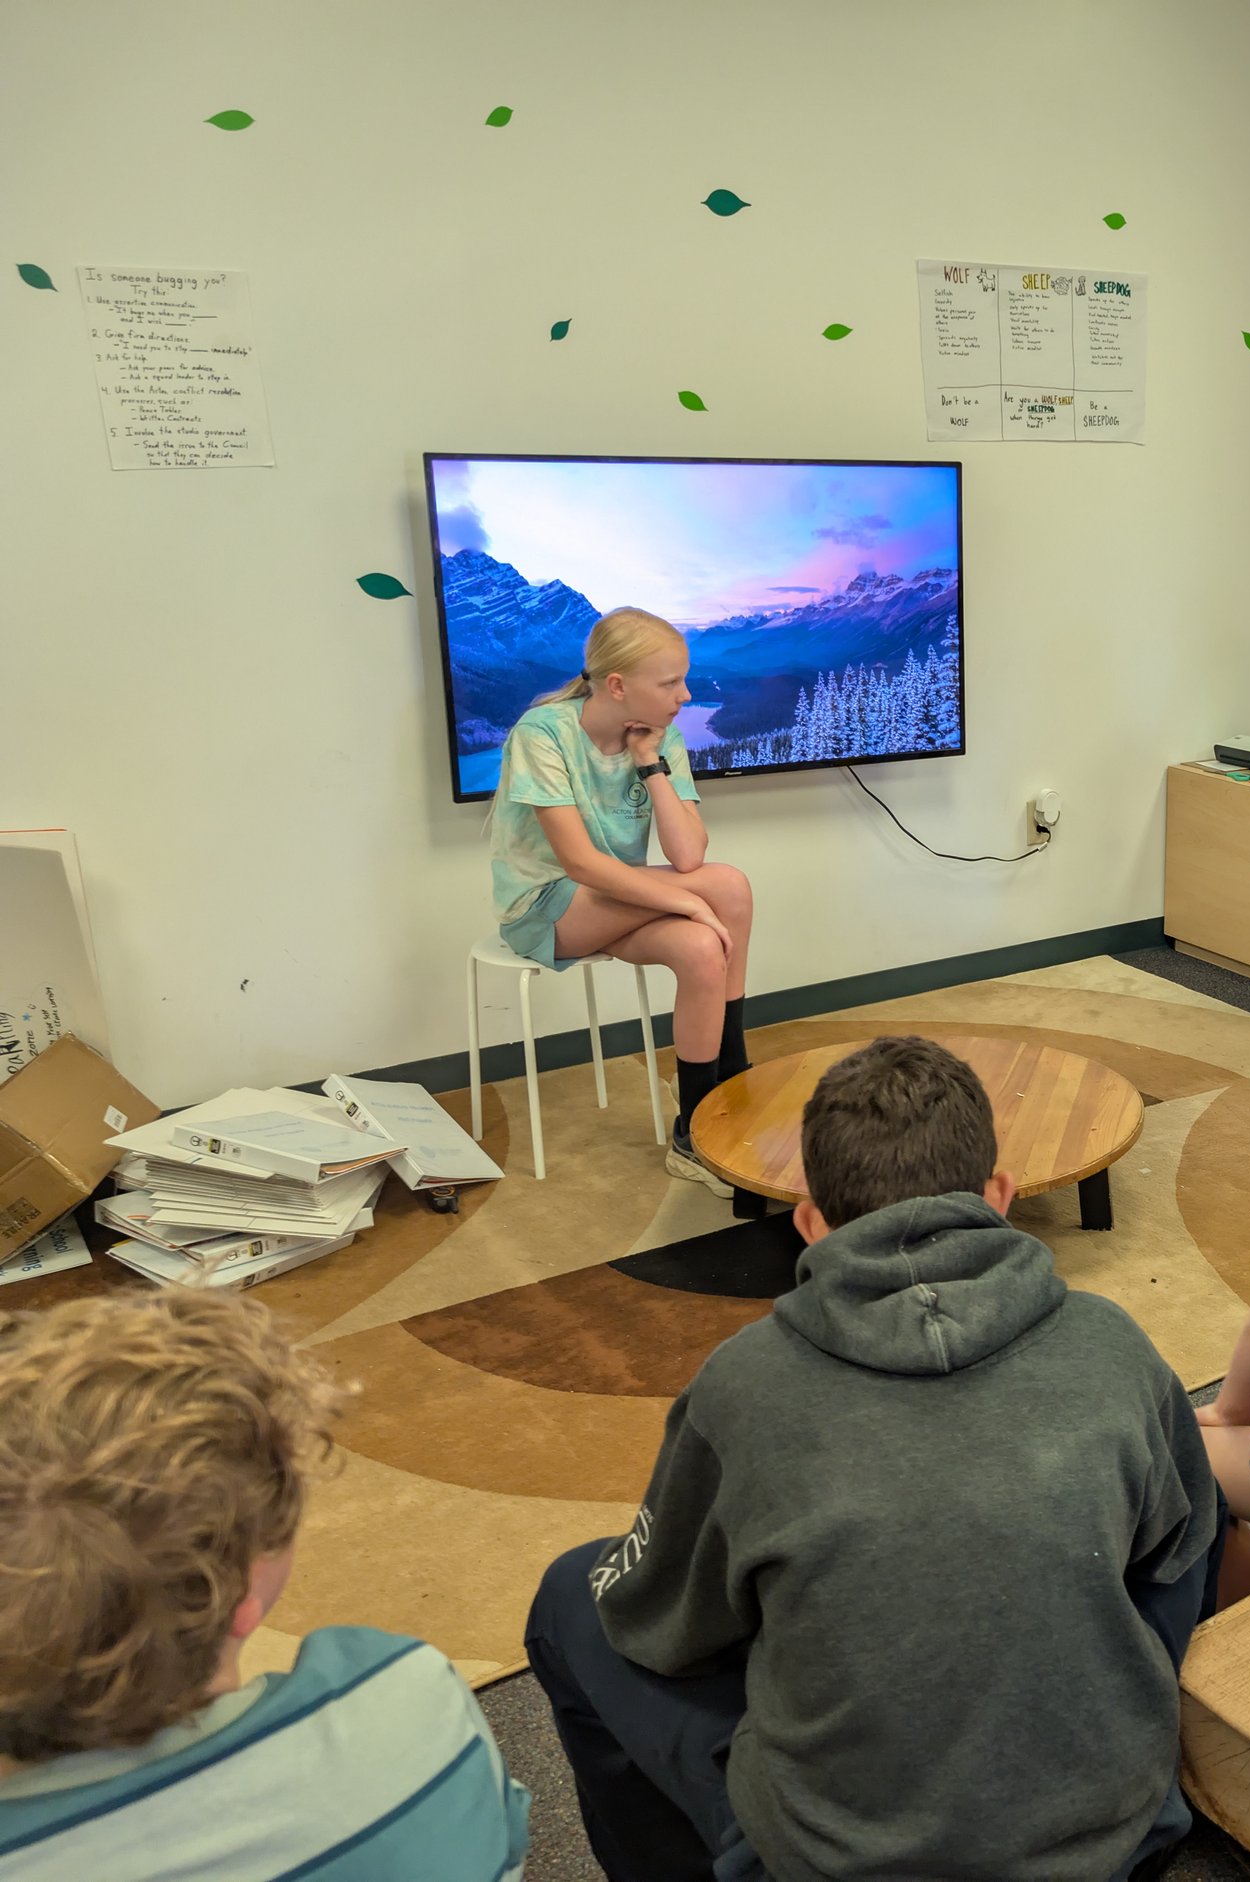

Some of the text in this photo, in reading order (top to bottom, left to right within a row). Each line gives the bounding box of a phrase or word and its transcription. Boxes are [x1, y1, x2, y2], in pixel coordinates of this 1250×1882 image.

[85, 268, 226, 290] Is someone bugging you?
[944, 266, 970, 284] WOLF
[1022, 273, 1050, 290] SHEEP
[130, 285, 147, 298] Try
[1094, 281, 1131, 298] SHEEPDOG
[104, 329, 124, 338] Give
[128, 330, 144, 339] firm
[175, 344, 188, 353] stop
[207, 374, 220, 383] step
[173, 387, 204, 395] conflict
[208, 388, 242, 396] resolution
[942, 394, 958, 406] Don't
[963, 396, 972, 406] be
[1004, 391, 1013, 403] Are
[1020, 396, 1031, 408] you
[1090, 401, 1098, 410] Be
[950, 417, 968, 427] WOLF
[1083, 414, 1120, 427] SHEEPDOG
[125, 427, 154, 436] Involve
[177, 427, 199, 435] studio
